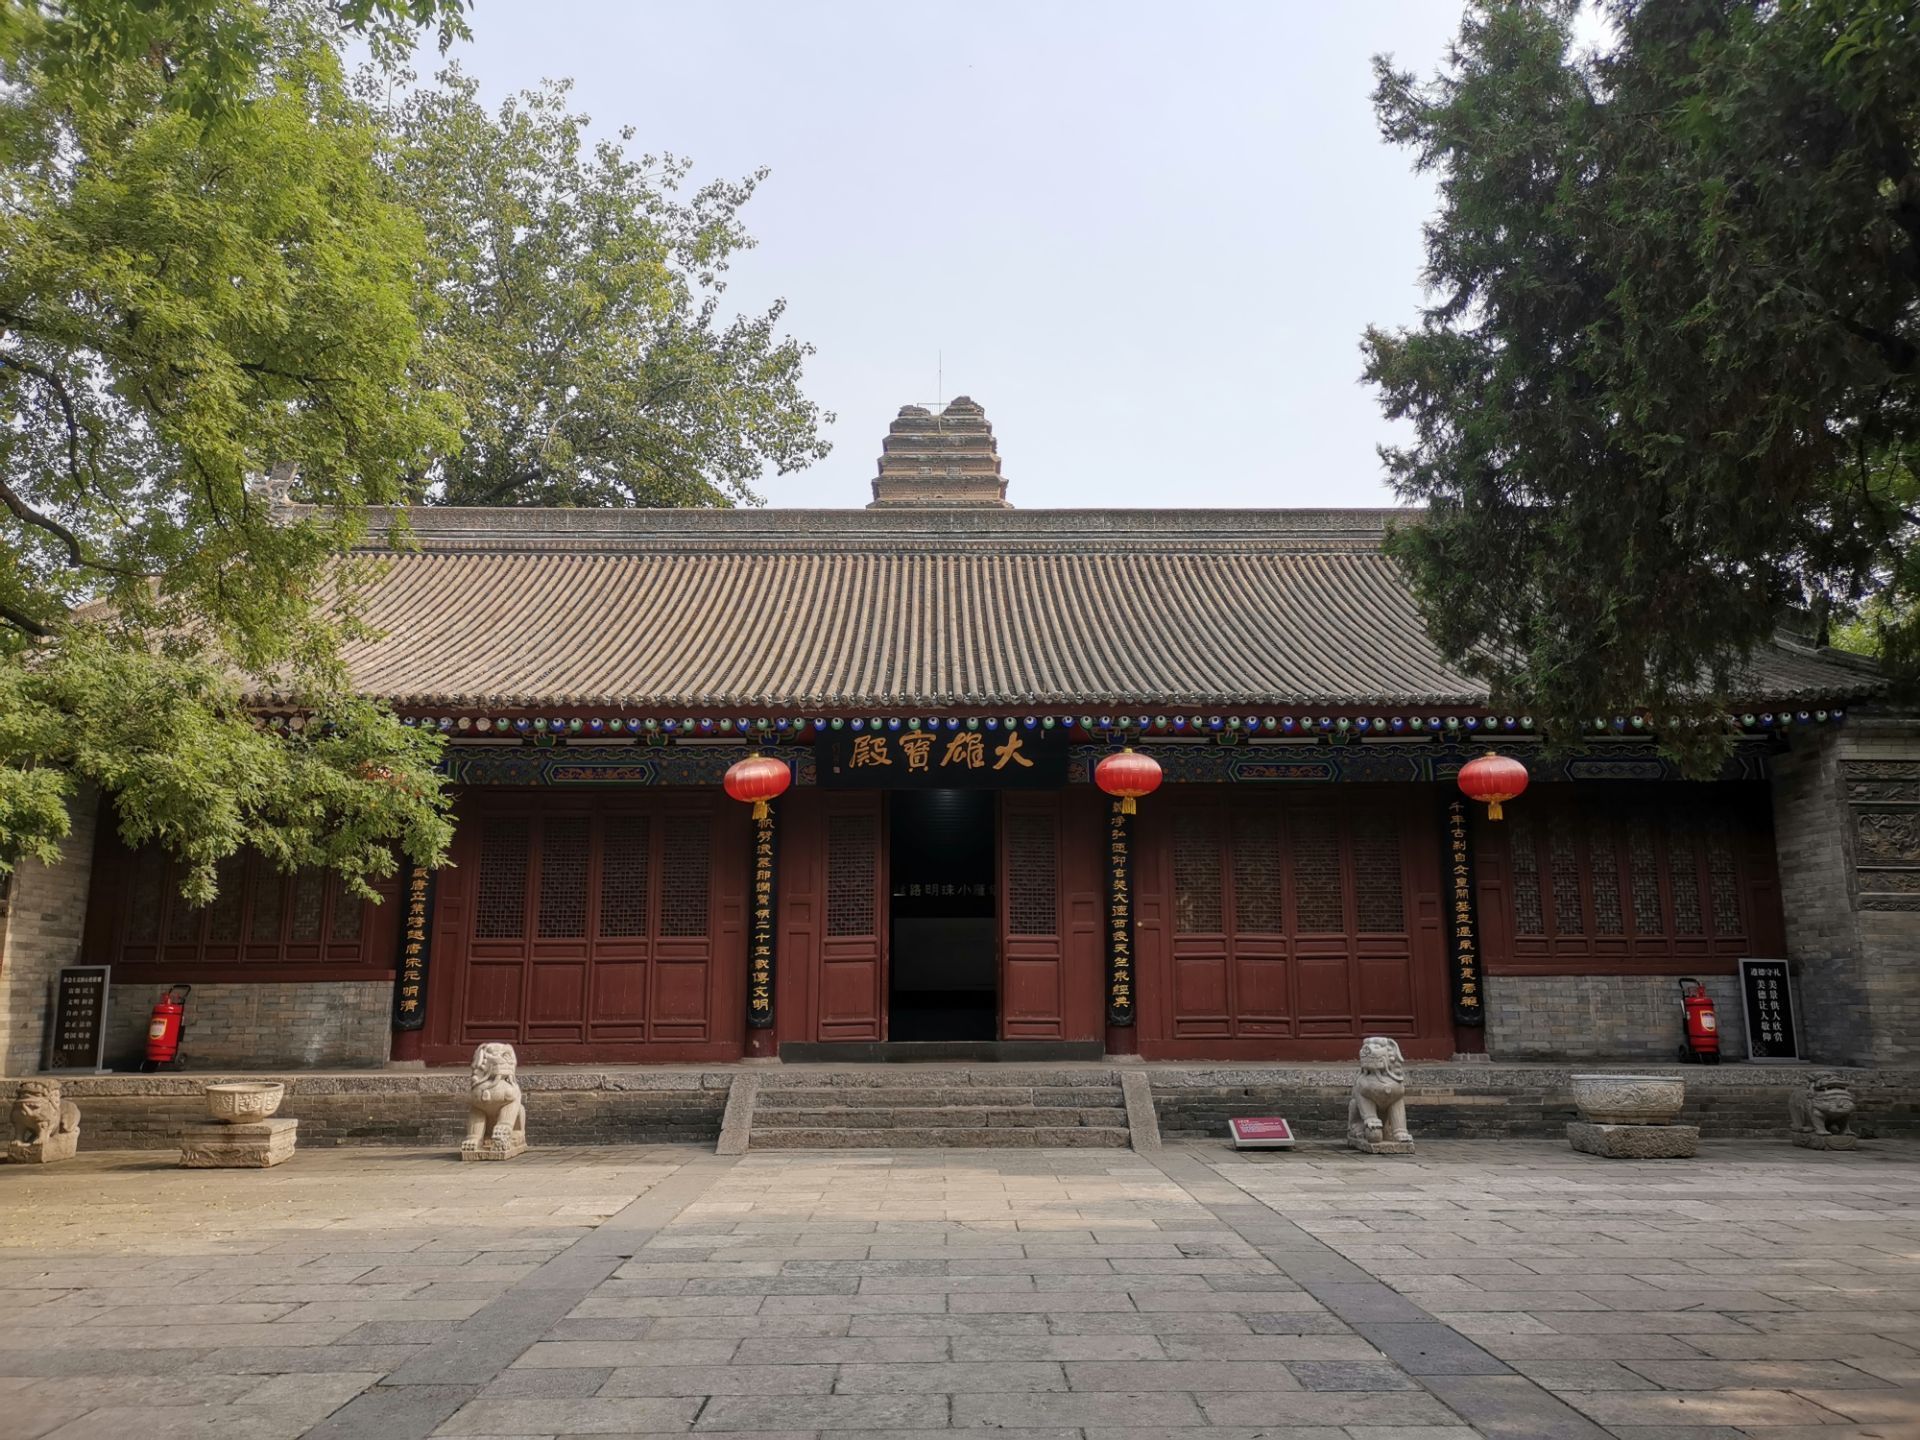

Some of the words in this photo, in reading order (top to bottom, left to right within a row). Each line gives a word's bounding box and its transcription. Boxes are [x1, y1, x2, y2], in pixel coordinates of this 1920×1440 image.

[1769, 980, 1783, 1042] 美景供人欣赏
